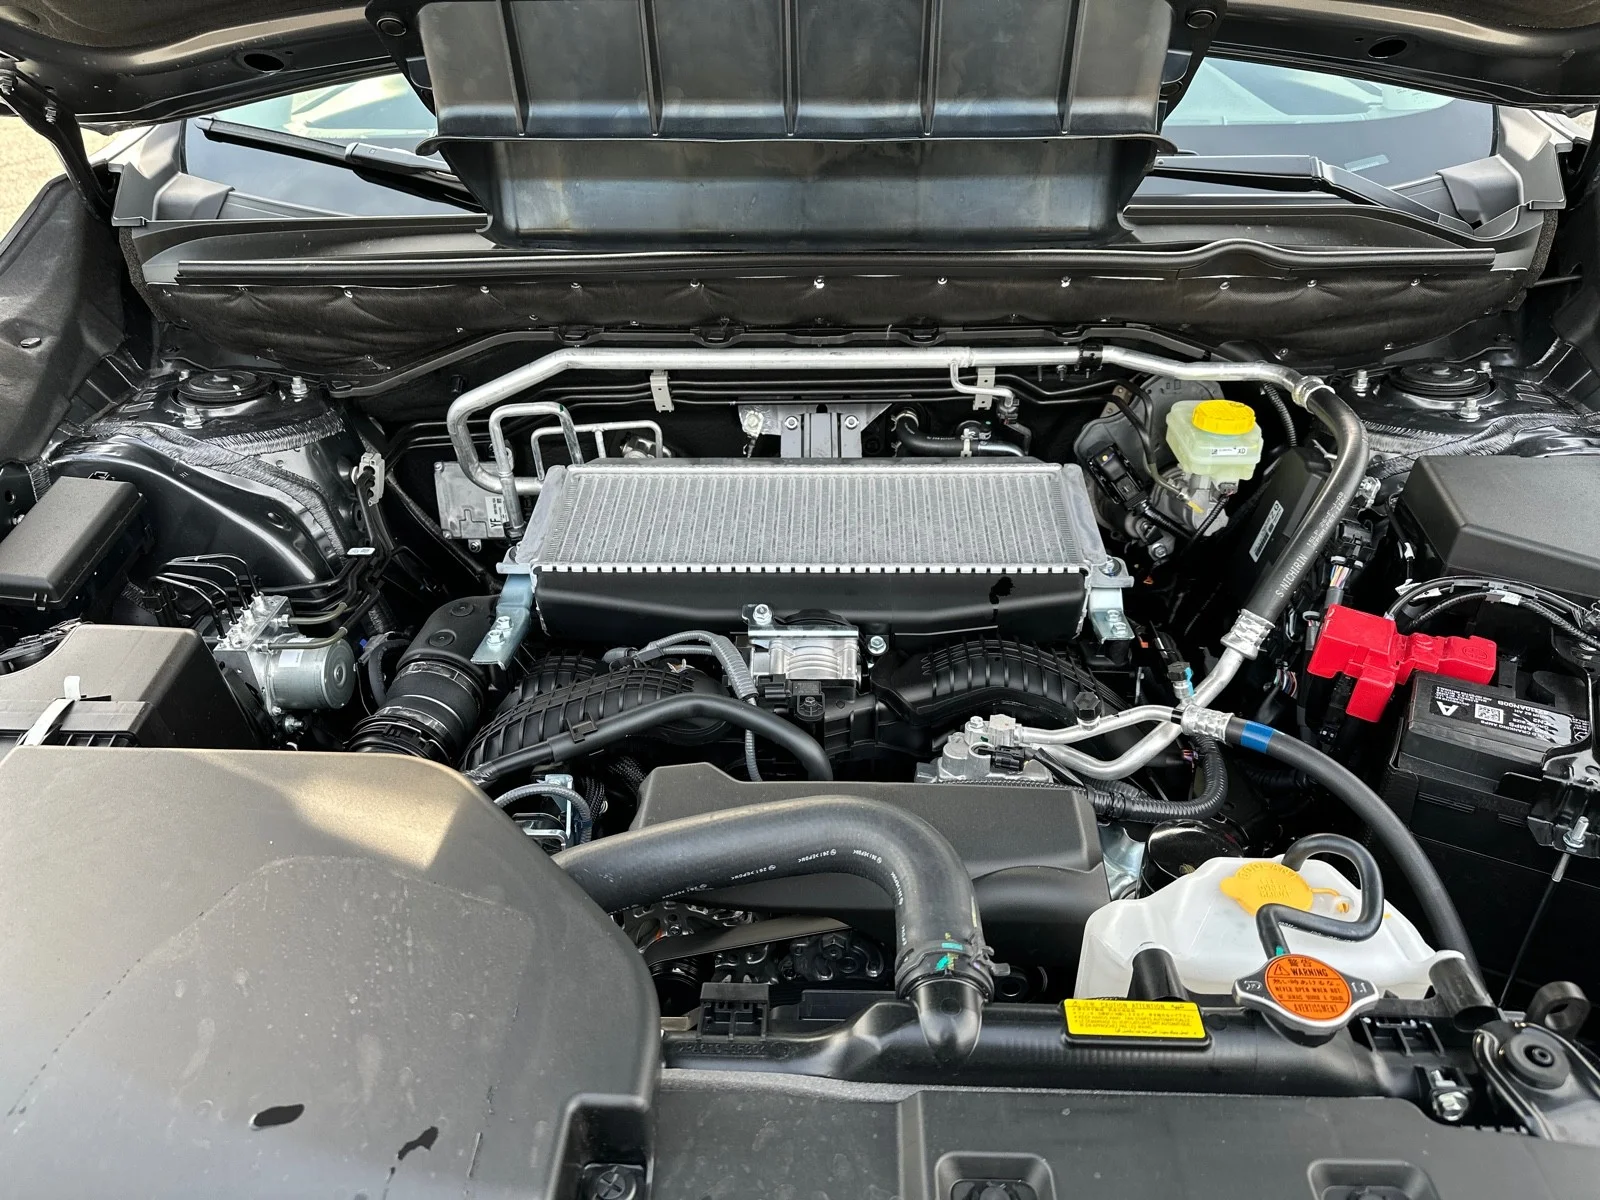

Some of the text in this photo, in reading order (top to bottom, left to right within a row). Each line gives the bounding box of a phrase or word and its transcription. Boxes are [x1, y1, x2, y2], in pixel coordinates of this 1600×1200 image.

[490, 518, 501, 528] YF
[1436, 700, 1459, 716] A
[1498, 724, 1531, 735] CRANKING
[1508, 721, 1533, 731] AMPS
[1237, 863, 1297, 880] COOLANT
[1288, 959, 1312, 967] 警告
[1290, 968, 1328, 977] WARNING
